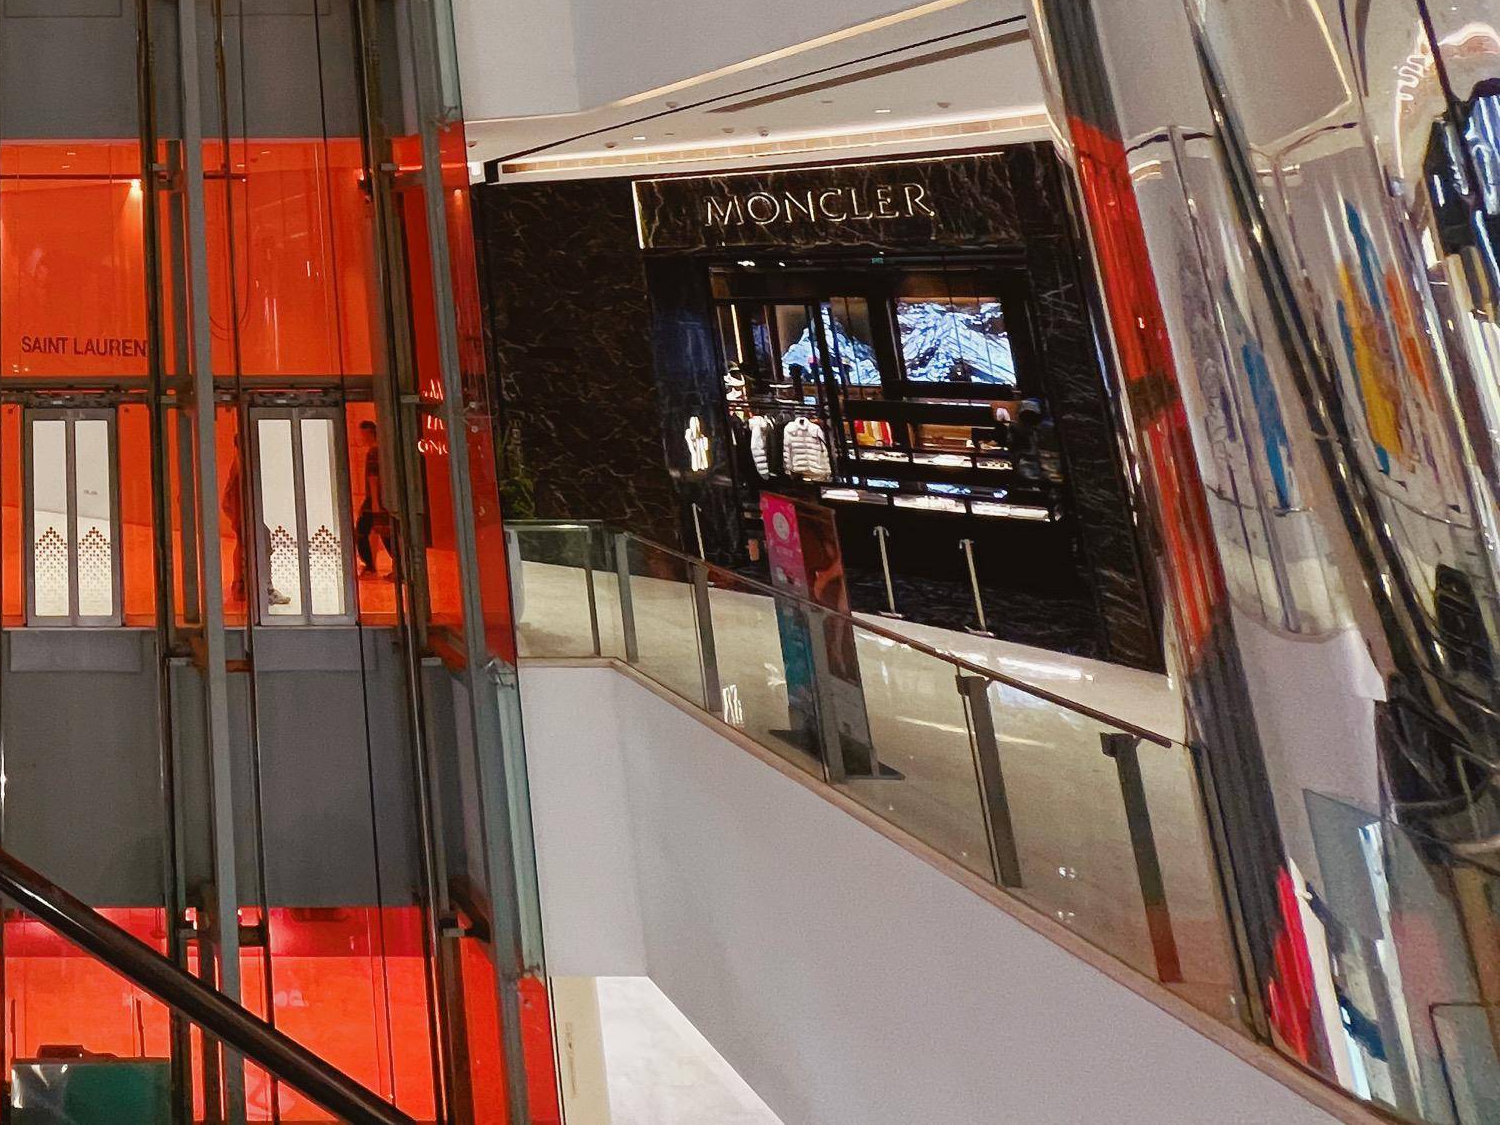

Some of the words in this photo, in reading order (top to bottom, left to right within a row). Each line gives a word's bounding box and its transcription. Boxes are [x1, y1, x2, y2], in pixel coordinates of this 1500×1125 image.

[705, 183, 935, 225] MONCLER
[21, 335, 68, 355] SAINT
[73, 338, 148, 357] LAUREN
